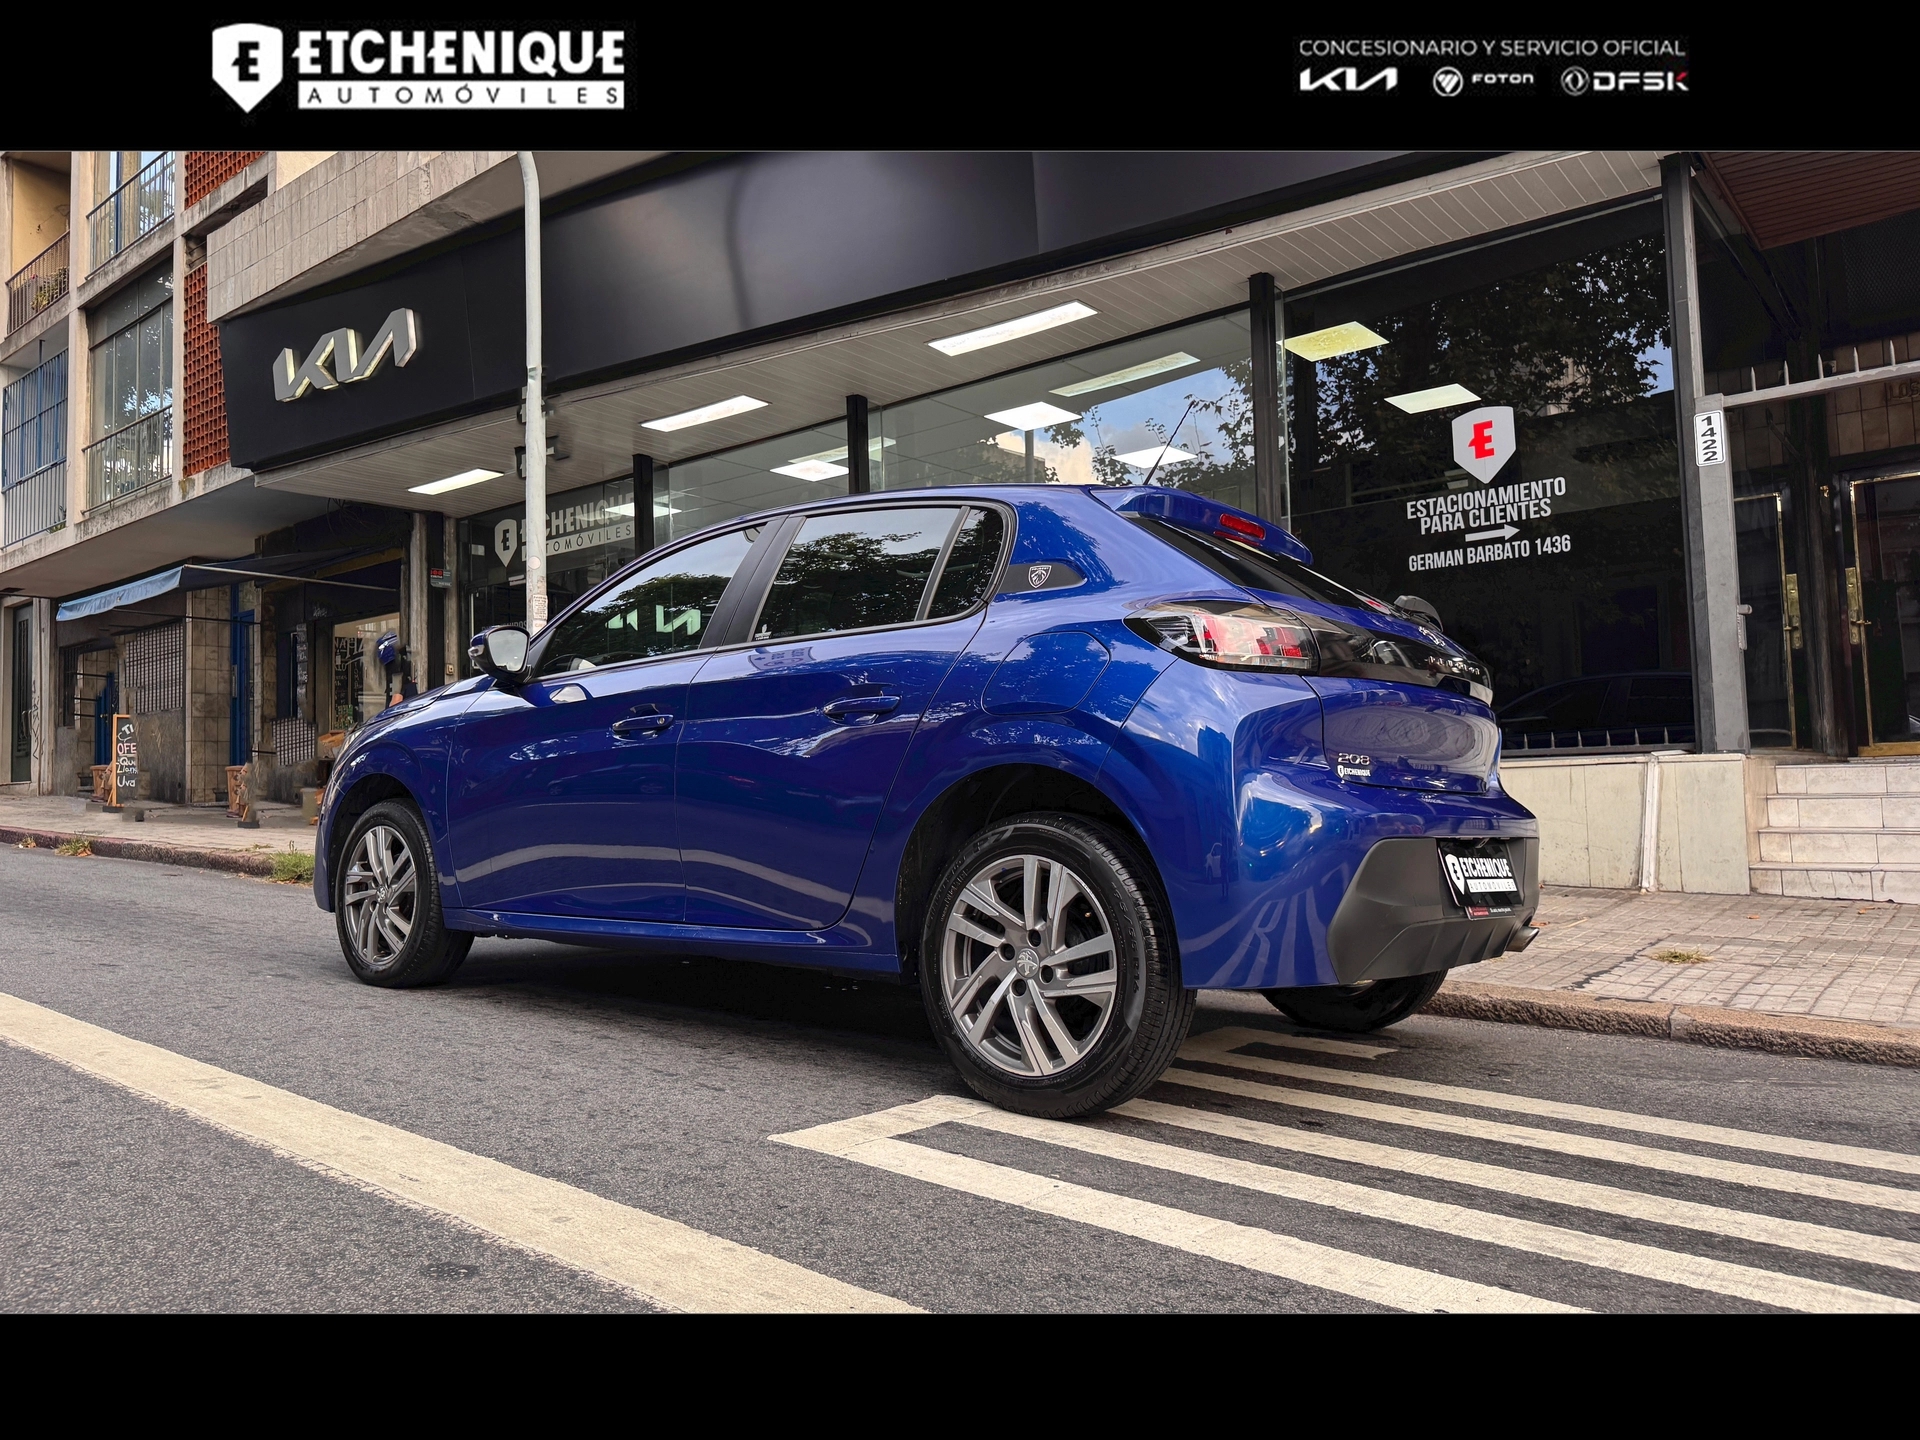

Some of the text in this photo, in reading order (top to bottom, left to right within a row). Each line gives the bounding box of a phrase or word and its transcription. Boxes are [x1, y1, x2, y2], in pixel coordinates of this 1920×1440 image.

[272, 307, 417, 403] KIA
[1701, 415, 1718, 462] 1422
[520, 492, 635, 543] HENIQU
[1406, 477, 1566, 520] ESTACIONAMIENTO
[1420, 498, 1552, 535] PARA CLIENTES
[545, 521, 634, 555] TOMÓVILES
[1408, 534, 1571, 572] GERMAN BARBATO 1436
[1337, 752, 1371, 766] 208
[1458, 857, 1513, 878] ETCHENIQUE
